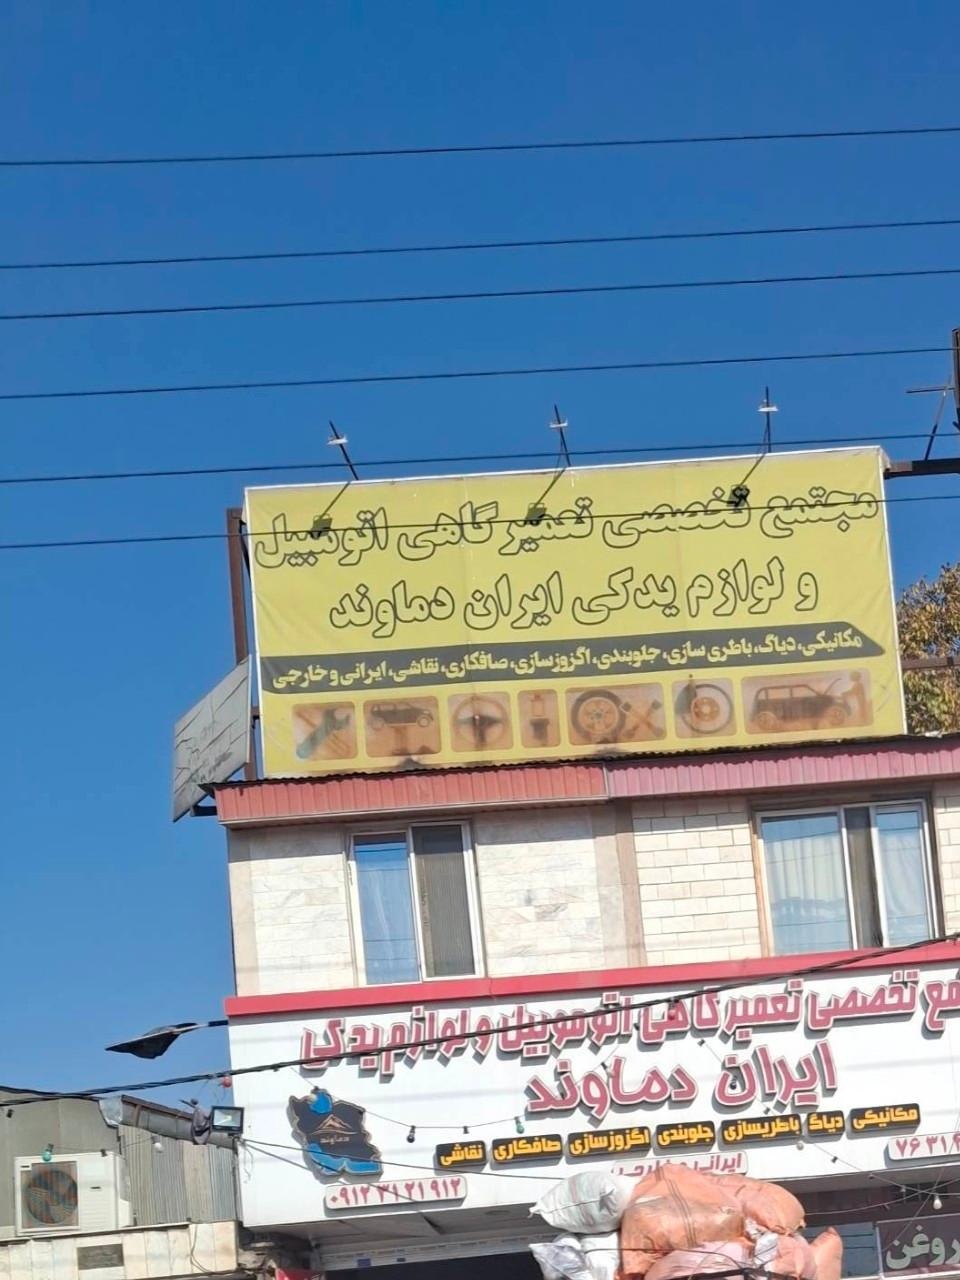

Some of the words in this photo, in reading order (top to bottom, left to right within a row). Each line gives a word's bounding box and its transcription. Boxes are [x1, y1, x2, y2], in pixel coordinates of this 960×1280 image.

[602, 486, 751, 549] تخصصی
[760, 486, 879, 539] مجتمع
[254, 506, 389, 569] اتومبیل
[329, 578, 455, 639] دماوند
[463, 570, 564, 631] ایران
[571, 566, 680, 626] یدکی
[685, 555, 786, 619] لوازم
[794, 571, 819, 612] و
[272, 665, 327, 688] خارجی
[329, 669, 338, 688] و
[339, 660, 386, 686] ایرانی
[806, 969, 919, 1030] تخصصی
[300, 1018, 380, 1069] یدکی
[381, 1006, 471, 1075] لوازم
[475, 1014, 494, 1055] و
[498, 991, 634, 1057] اتوموبیل
[526, 1056, 699, 1120] دماوند
[715, 1040, 837, 1105] ایران
[658, 1124, 714, 1145] جلوبندی
[808, 1112, 843, 1131] دیاگ
[853, 1107, 918, 1131] مکانیکی
[440, 1144, 483, 1168] نقاشی
[493, 1136, 561, 1162] صافکاری
[896, 1137, 921, 1158] ۷۶
[926, 1135, 948, 1155] ۳۱
[330, 1186, 370, 1207] ۰۹۱۲
[404, 1181, 424, 1200] ۲۱
[430, 1178, 460, 1198] ۹۱۲
[886, 1224, 960, 1269] روغن
